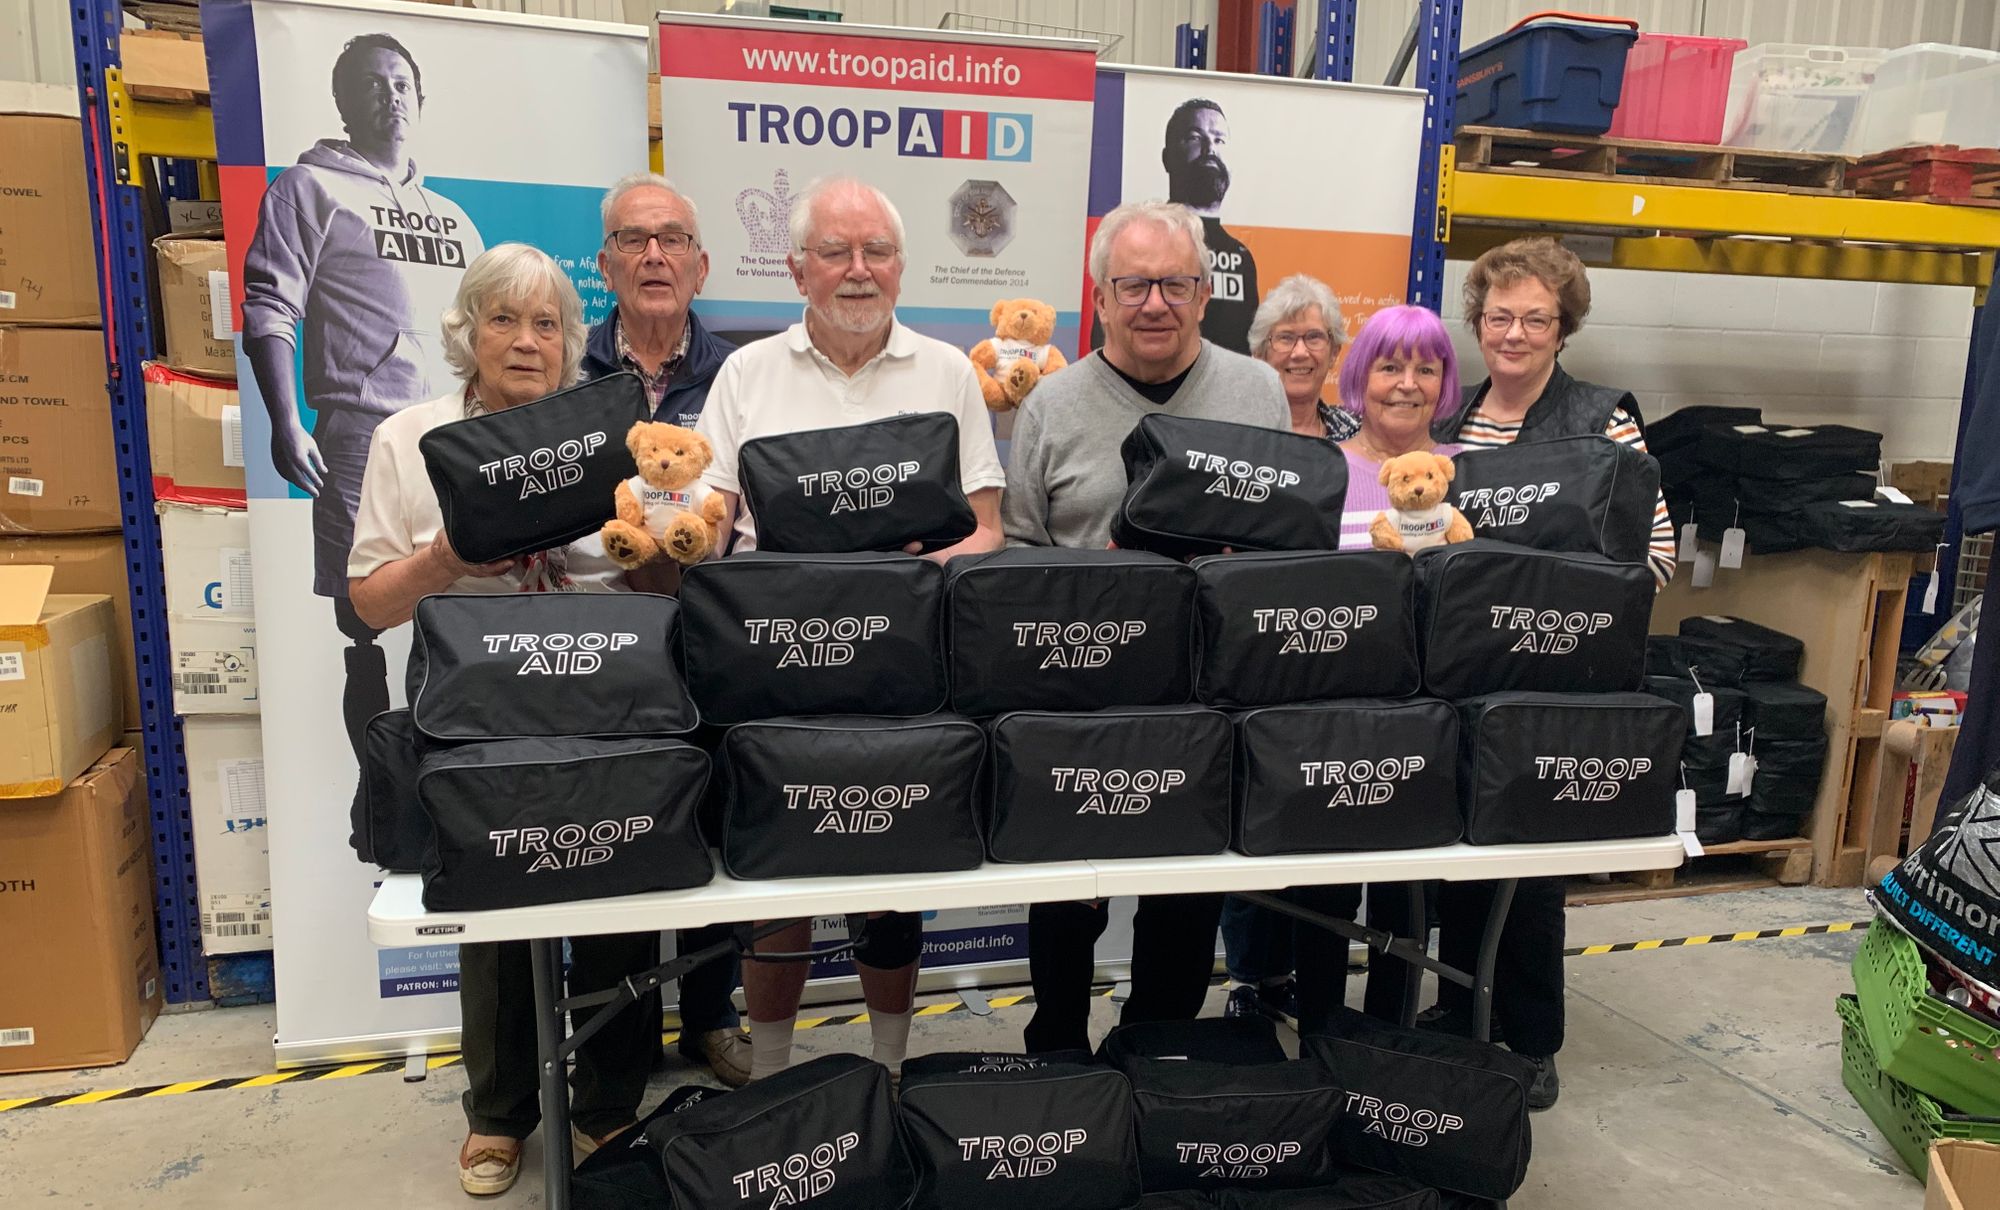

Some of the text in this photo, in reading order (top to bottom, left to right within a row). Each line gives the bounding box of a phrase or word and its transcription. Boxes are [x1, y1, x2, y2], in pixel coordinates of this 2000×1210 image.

[742, 46, 1021, 86] www.troopaid.info
[370, 205, 457, 235] TROOP
[378, 231, 464, 267] AID
[741, 256, 756, 264] The
[554, 255, 599, 273] from Afg
[736, 267, 792, 280] for Voluntary
[950, 266, 970, 274] Chief
[981, 267, 993, 275] the
[995, 268, 1026, 276] Defence
[578, 276, 608, 293] nothing
[930, 276, 1030, 287] Staff Commendation 2014
[592, 295, 607, 308] Aid
[8, 375, 29, 383] CM
[23, 397, 69, 406] TOWEL
[3, 436, 29, 444] PCS
[479, 431, 607, 486] TROOP
[1186, 449, 1301, 488] TROOP
[519, 463, 583, 500] AID
[798, 460, 920, 497] TROOP
[1205, 475, 1271, 503] AID
[830, 485, 894, 516] AID
[1459, 482, 1560, 511] TROOP
[1475, 504, 1530, 529] AID
[745, 615, 890, 644] TROOP
[1253, 605, 1378, 633] TROOP
[1490, 605, 1613, 635] TROOP
[483, 632, 638, 653] TROOP
[1013, 620, 1147, 647] TROOP
[1278, 630, 1348, 655] AID
[1510, 631, 1578, 655] AID
[517, 652, 602, 675] AID
[776, 642, 855, 669] AID
[1039, 645, 1112, 670] AID
[1052, 768, 1185, 793] TROOP
[1300, 755, 1425, 786] TROOP
[1535, 756, 1652, 780] TROOP
[783, 784, 930, 810] TROOP
[1327, 782, 1394, 809] AID
[1553, 780, 1620, 801] AID
[1076, 793, 1151, 815] AID
[813, 810, 893, 833] AID
[489, 815, 654, 857] TROOP
[526, 845, 614, 874] AID
[1880, 872, 1997, 967] BUILT DIFFERENT
[408, 950, 458, 960] For further
[385, 965, 417, 976] please
[420, 963, 442, 971] visit:
[396, 980, 458, 992] PATRON: His
[1346, 1090, 1464, 1135] TROOP
[958, 1128, 1087, 1161] TROOP
[1364, 1119, 1429, 1148] AID
[1176, 1141, 1301, 1164] TROOP
[733, 1131, 859, 1200] TROOP
[986, 1156, 1057, 1181] AID
[1199, 1164, 1268, 1179] AID
[769, 1168, 836, 1210] AID
